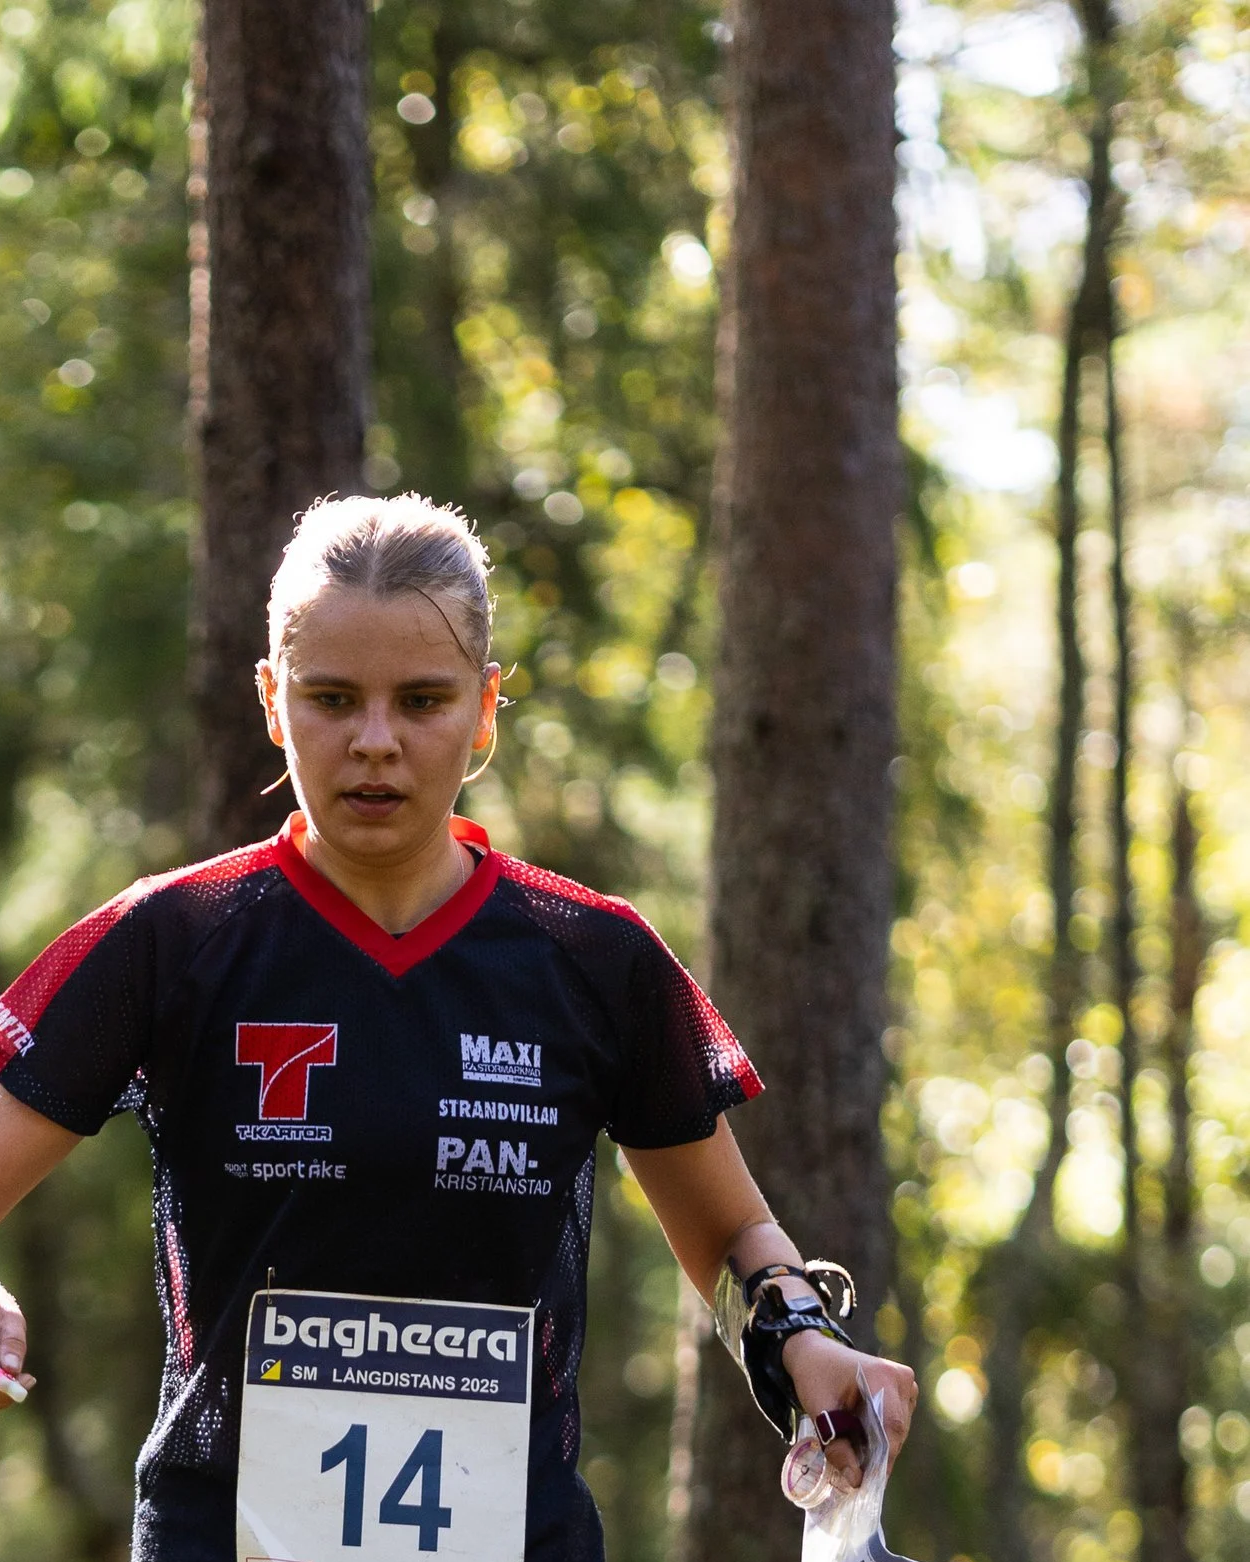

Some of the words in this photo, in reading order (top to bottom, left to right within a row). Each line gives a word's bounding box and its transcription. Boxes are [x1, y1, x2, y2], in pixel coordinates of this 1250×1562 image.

[460, 1033, 541, 1068] MAXI
[478, 1062, 541, 1077] STORMARKNAD
[439, 1098, 558, 1125] STRANDVILLAN
[236, 1125, 332, 1141] T-KARTOR
[436, 1136, 538, 1176] PAN-
[434, 1173, 551, 1195] KRISTIANSTAD
[264, 1306, 516, 1361] bagheera
[292, 1366, 317, 1381] SM
[333, 1367, 456, 1391] LÅNGDISTANS
[461, 1377, 499, 1393] 2025
[320, 1424, 452, 1552] 14
